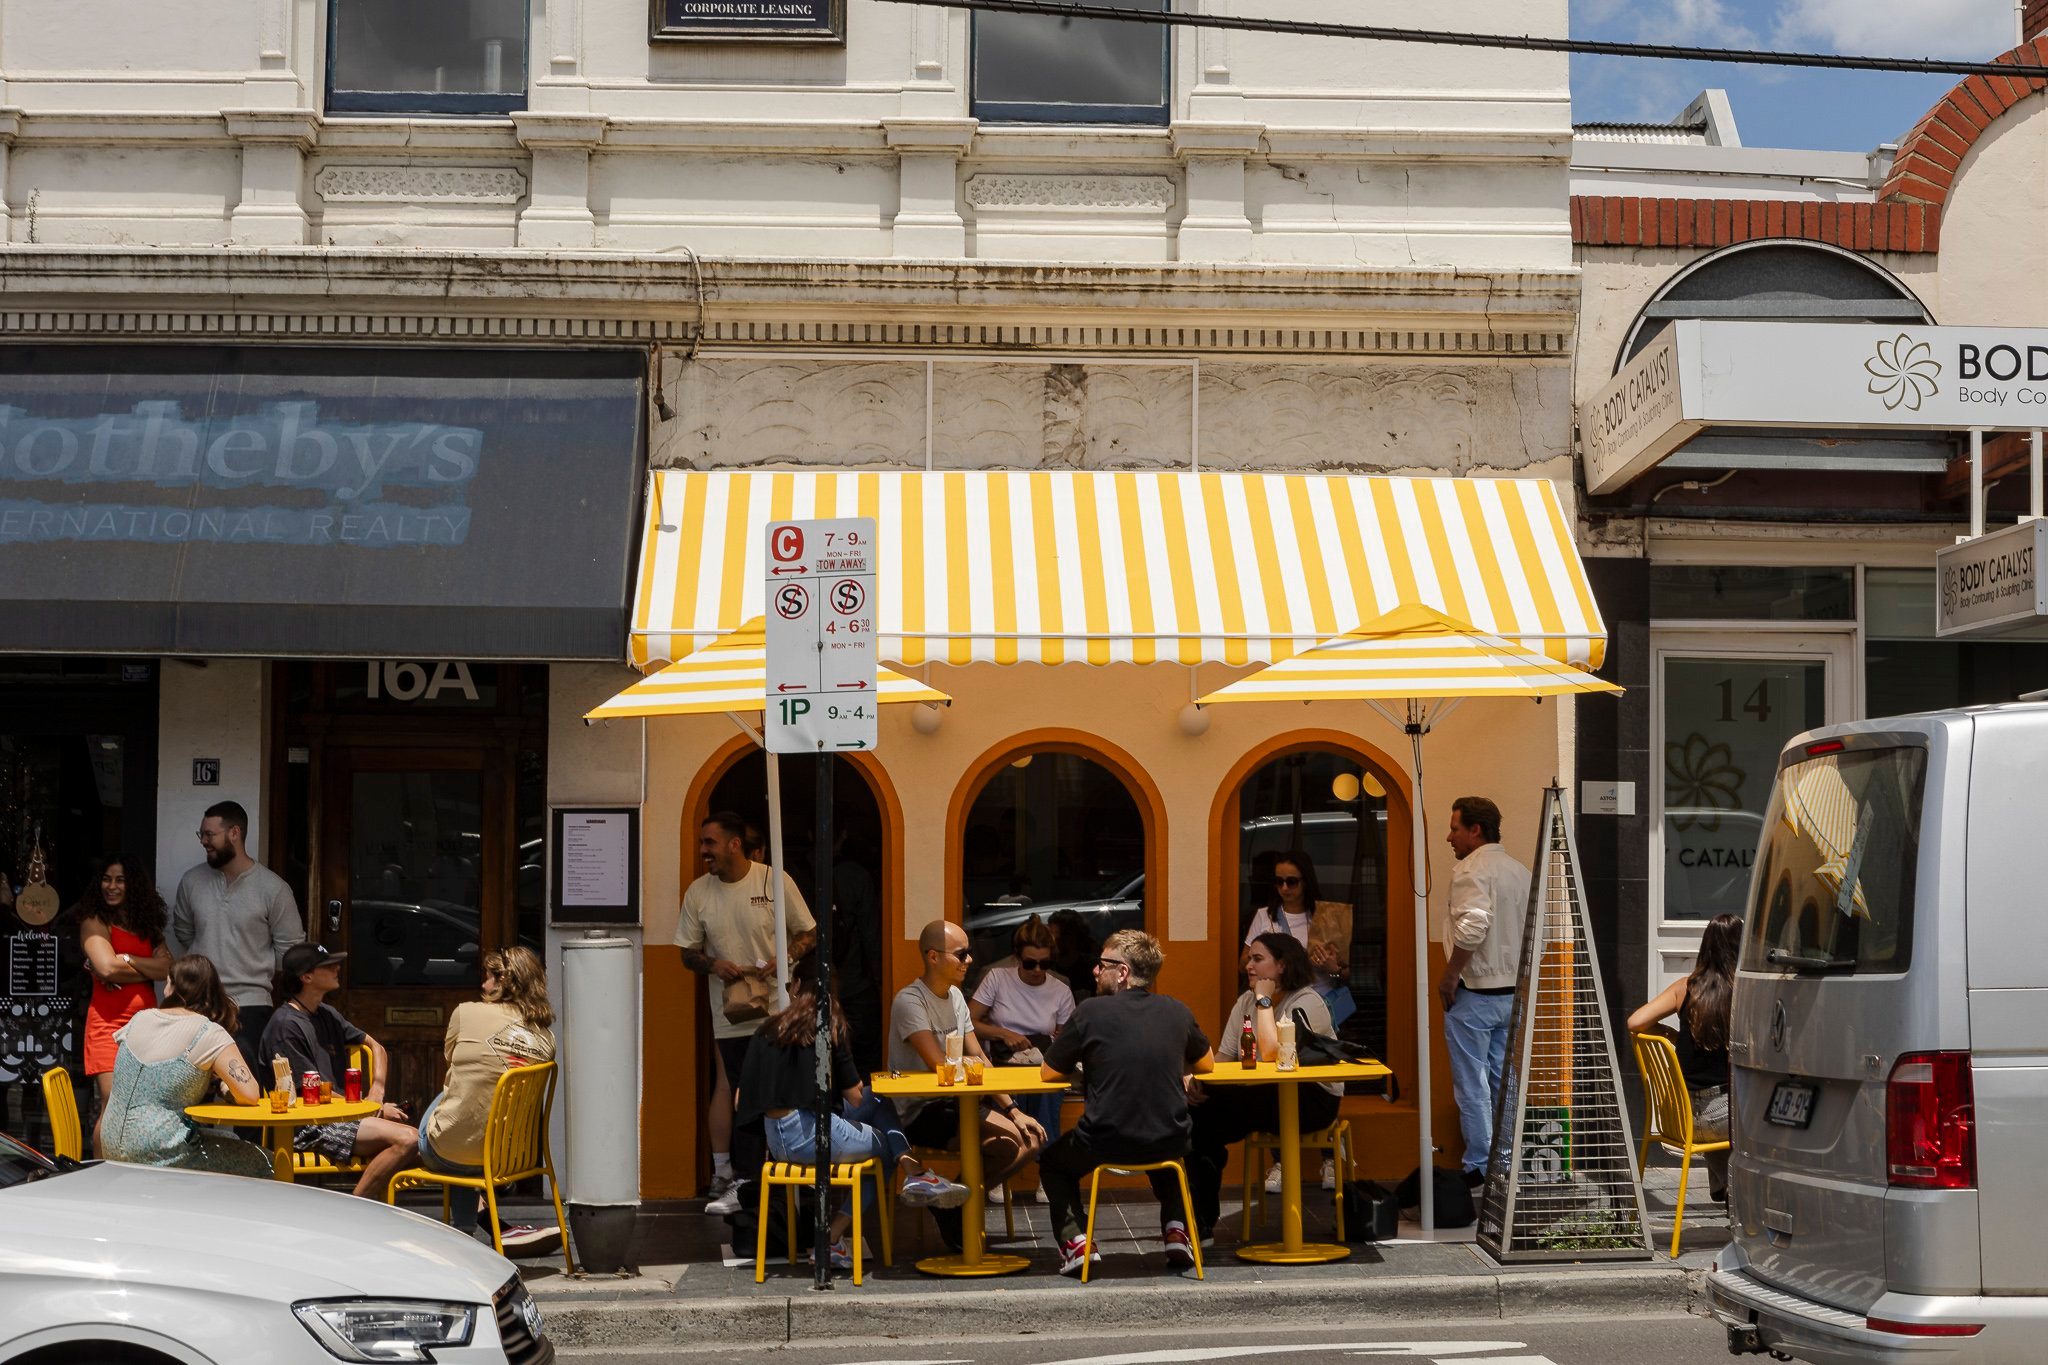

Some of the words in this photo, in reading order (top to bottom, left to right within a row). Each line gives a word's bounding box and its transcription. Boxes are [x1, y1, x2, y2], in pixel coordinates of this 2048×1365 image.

[684, 3, 758, 14] CORPORATE
[760, 3, 813, 15] LEASING
[1603, 385, 1628, 436] BODY
[1629, 345, 1671, 412] CATALYST
[1960, 386, 2009, 407] Body
[2017, 387, 2048, 405] Co
[308, 514, 468, 542] REALTY
[818, 559, 836, 570] TOW
[839, 559, 863, 570] AWAY
[1960, 561, 1986, 593] BODY
[1988, 546, 2034, 584] CATALYST
[367, 661, 480, 701] 16A
[779, 698, 811, 726] 1P
[1713, 678, 1772, 723] 14
[1679, 847, 1757, 868] CATAL
[17, 929, 51, 942] Welcome
